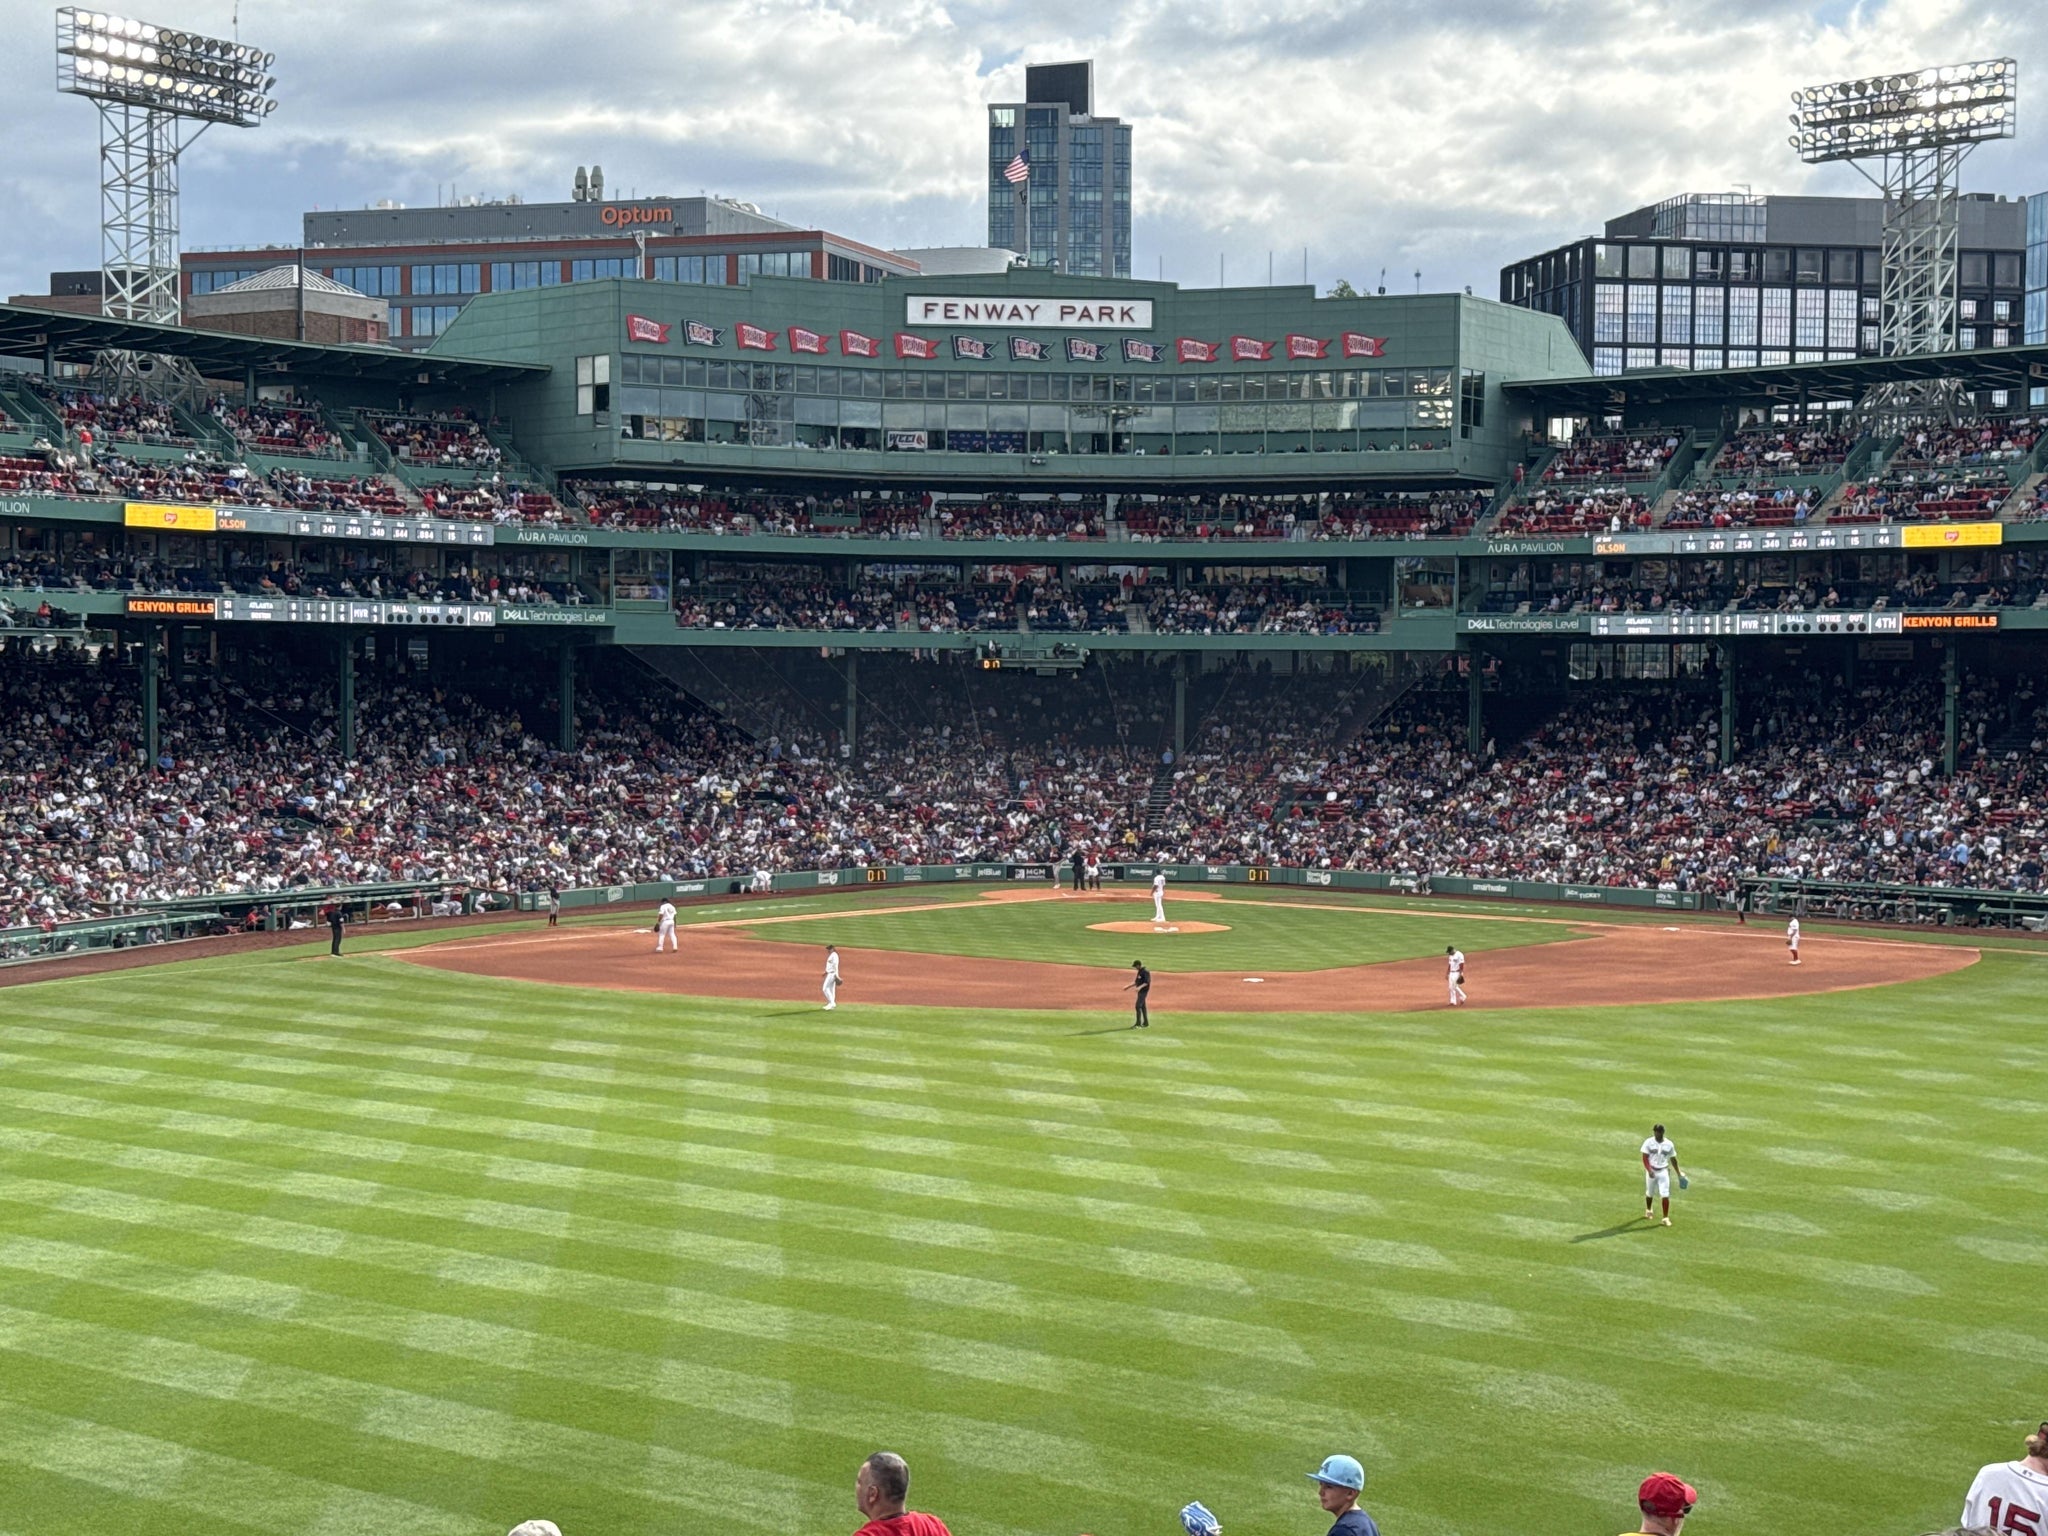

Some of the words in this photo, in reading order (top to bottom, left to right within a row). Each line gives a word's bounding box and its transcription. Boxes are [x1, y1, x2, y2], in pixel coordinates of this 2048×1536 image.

[601, 206, 672, 229] Optum
[923, 303, 1041, 321] FENWAY
[1060, 305, 1135, 322] PARK
[219, 519, 246, 529] OLSON
[300, 523, 310, 532] 56
[322, 525, 336, 534] 247
[473, 533, 483, 542] 44
[549, 533, 588, 544] PAVILION
[1520, 543, 1564, 553] PAVILION
[1597, 543, 1626, 553] OLSON
[1685, 542, 1696, 551] 56
[1709, 541, 1725, 550] 247
[1850, 537, 1860, 546] 15
[1878, 536, 1890, 545] 44
[129, 600, 176, 613] KENYON
[176, 602, 215, 614] GRILLS
[392, 605, 408, 613] BALL
[418, 606, 440, 614] STRIKE
[448, 607, 462, 615] OUT
[473, 611, 492, 622] 4TH
[503, 610, 529, 621] DELL
[529, 610, 583, 624] Technologies
[584, 612, 606, 622] Level
[1786, 615, 1805, 623] BALL
[1816, 615, 1842, 623] STRIKE
[1848, 614, 1864, 622] OUT
[1903, 617, 1952, 628] KENYON
[1954, 616, 1998, 627] GRILLS
[1468, 619, 1495, 629] DELL
[1495, 619, 1553, 632] Technologies
[1555, 619, 1579, 629] Level
[1875, 617, 1897, 629] 4TH
[977, 867, 1002, 877] jetBlue
[1988, 1496, 2041, 1536] 15
